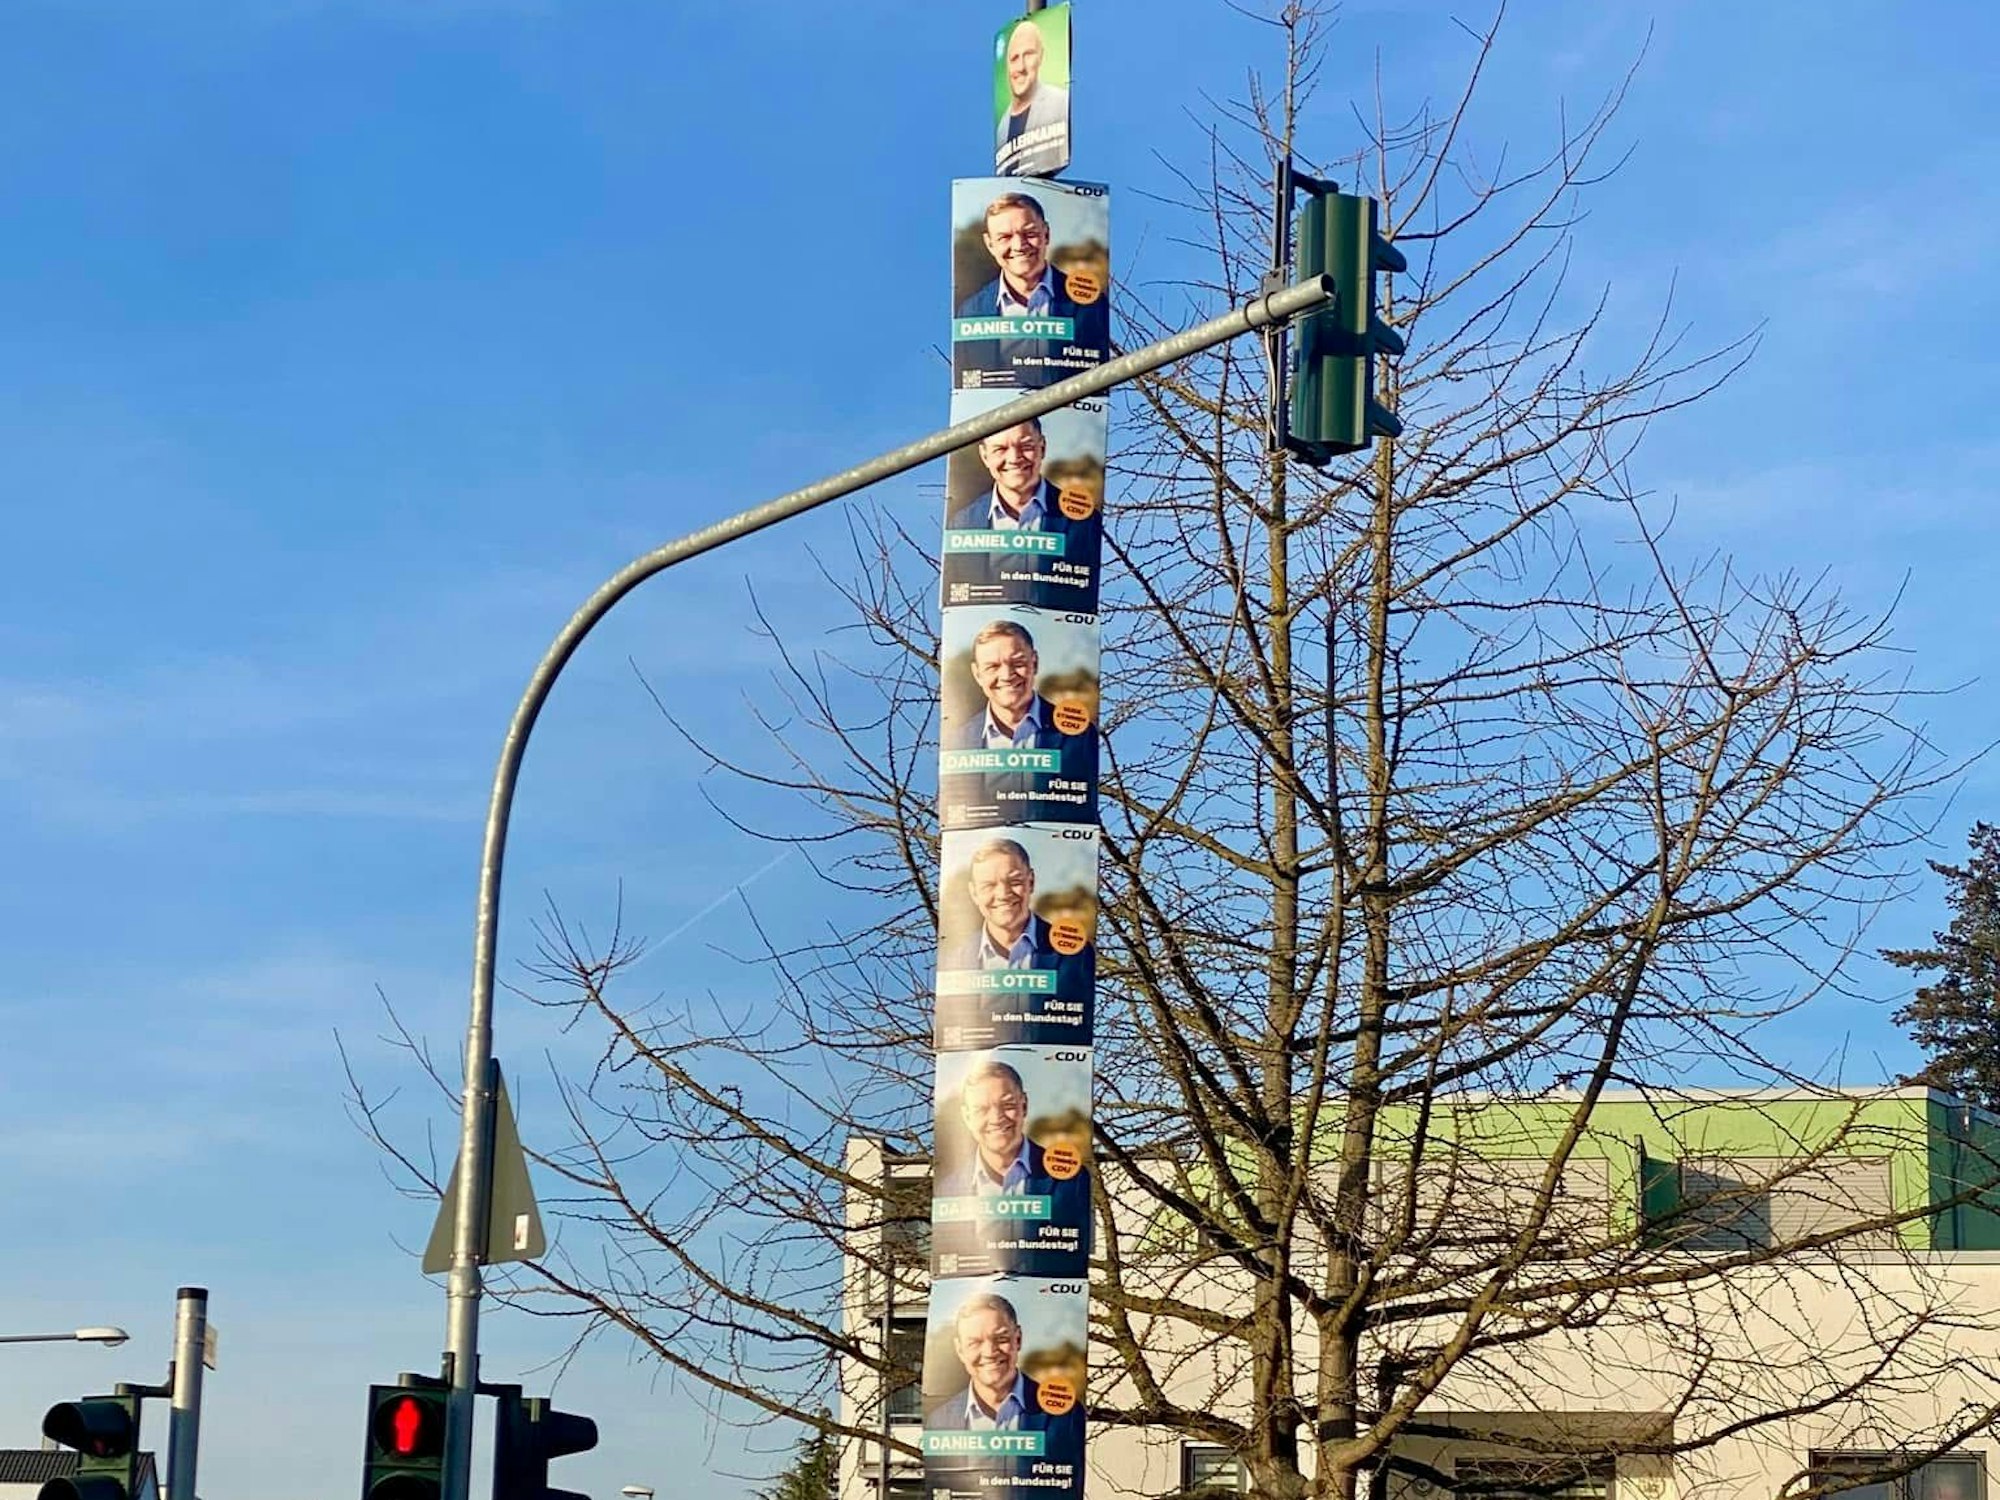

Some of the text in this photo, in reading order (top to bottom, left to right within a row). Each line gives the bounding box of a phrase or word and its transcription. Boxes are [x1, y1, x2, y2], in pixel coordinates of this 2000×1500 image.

[1074, 186, 1104, 197] CDU
[1073, 290, 1092, 299] CDU
[961, 321, 1065, 335] DANIEL OTTE
[1063, 345, 1100, 358] FÜR SIE
[1012, 356, 1022, 366] in
[1024, 357, 1043, 366] den
[1073, 400, 1102, 413] CDU
[1066, 506, 1085, 515] CDU
[951, 535, 1056, 550] DANIEL OTTE
[1052, 561, 1090, 575] FÜR SIE
[1000, 571, 1089, 588] in den Bundestag!
[1065, 614, 1094, 625] CDU
[1061, 721, 1080, 729] CDU
[946, 754, 1052, 768] DANIEL OTTE
[1048, 778, 1087, 791] FÜR SIE
[996, 790, 1087, 804] in den Bundestag!
[1062, 830, 1093, 840] CDU
[1057, 940, 1077, 949] CDU
[1002, 974, 1048, 988] OTTE
[1044, 999, 1084, 1012] FÜR SIE
[991, 1012, 1083, 1026] in den Bundestag!
[1055, 1051, 1087, 1062] CDU
[1051, 1165, 1071, 1174] CDU
[997, 1200, 1042, 1215] OTTE
[1038, 1225, 1079, 1238] FÜR SIE
[997, 1240, 1018, 1249] den
[1018, 1239, 1078, 1252] Bundestag!
[1050, 1284, 1082, 1294] CDU
[1045, 1399, 1065, 1408] CDU
[929, 1436, 1036, 1450] DANIEL OTTE
[1032, 1462, 1073, 1475] FÜR SIE
[979, 1476, 1072, 1489] in den Bundestag!
